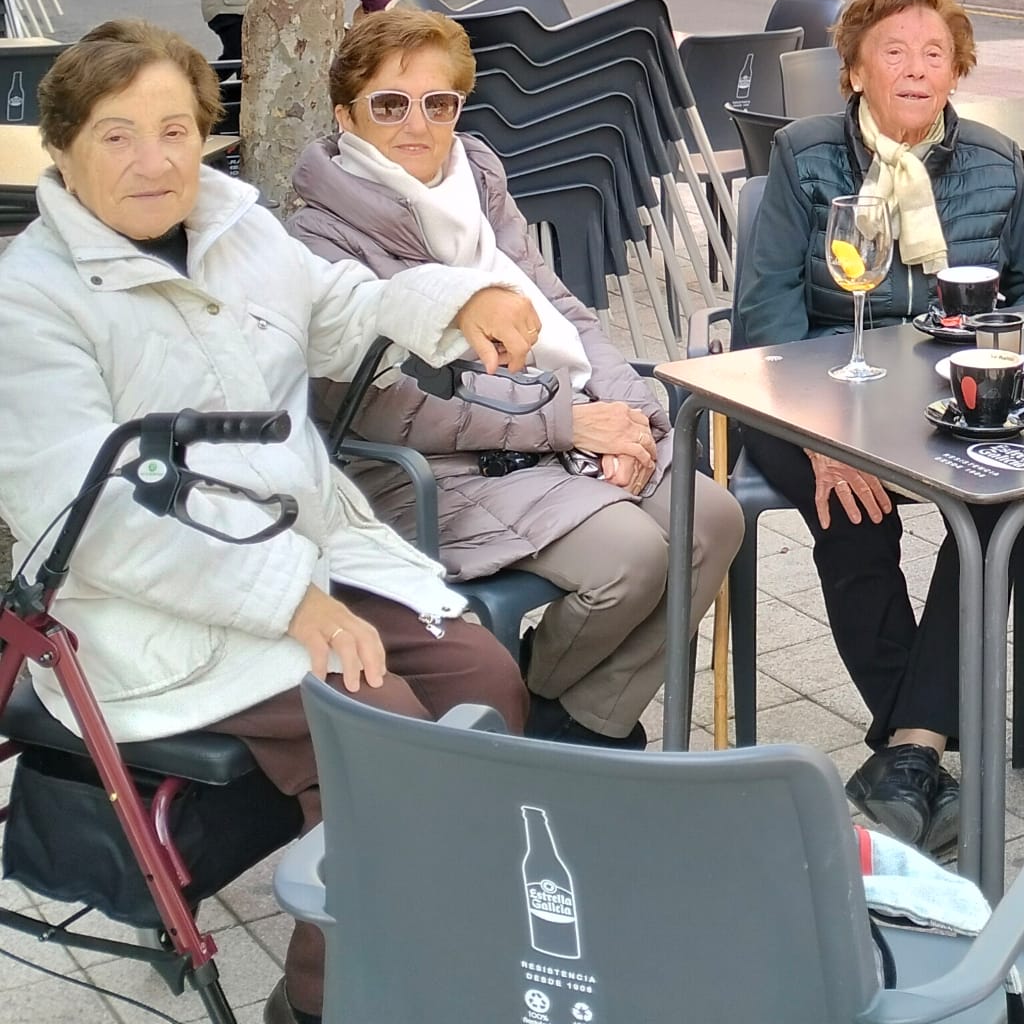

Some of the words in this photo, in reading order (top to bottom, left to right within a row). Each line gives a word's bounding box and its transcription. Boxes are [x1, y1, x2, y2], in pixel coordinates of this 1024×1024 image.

[529, 888, 573, 906] Estrella
[531, 898, 573, 916] Galicia
[521, 960, 597, 983] RESISTENCIA
[526, 972, 563, 987] DESDE
[528, 1010, 550, 1023] 100%
